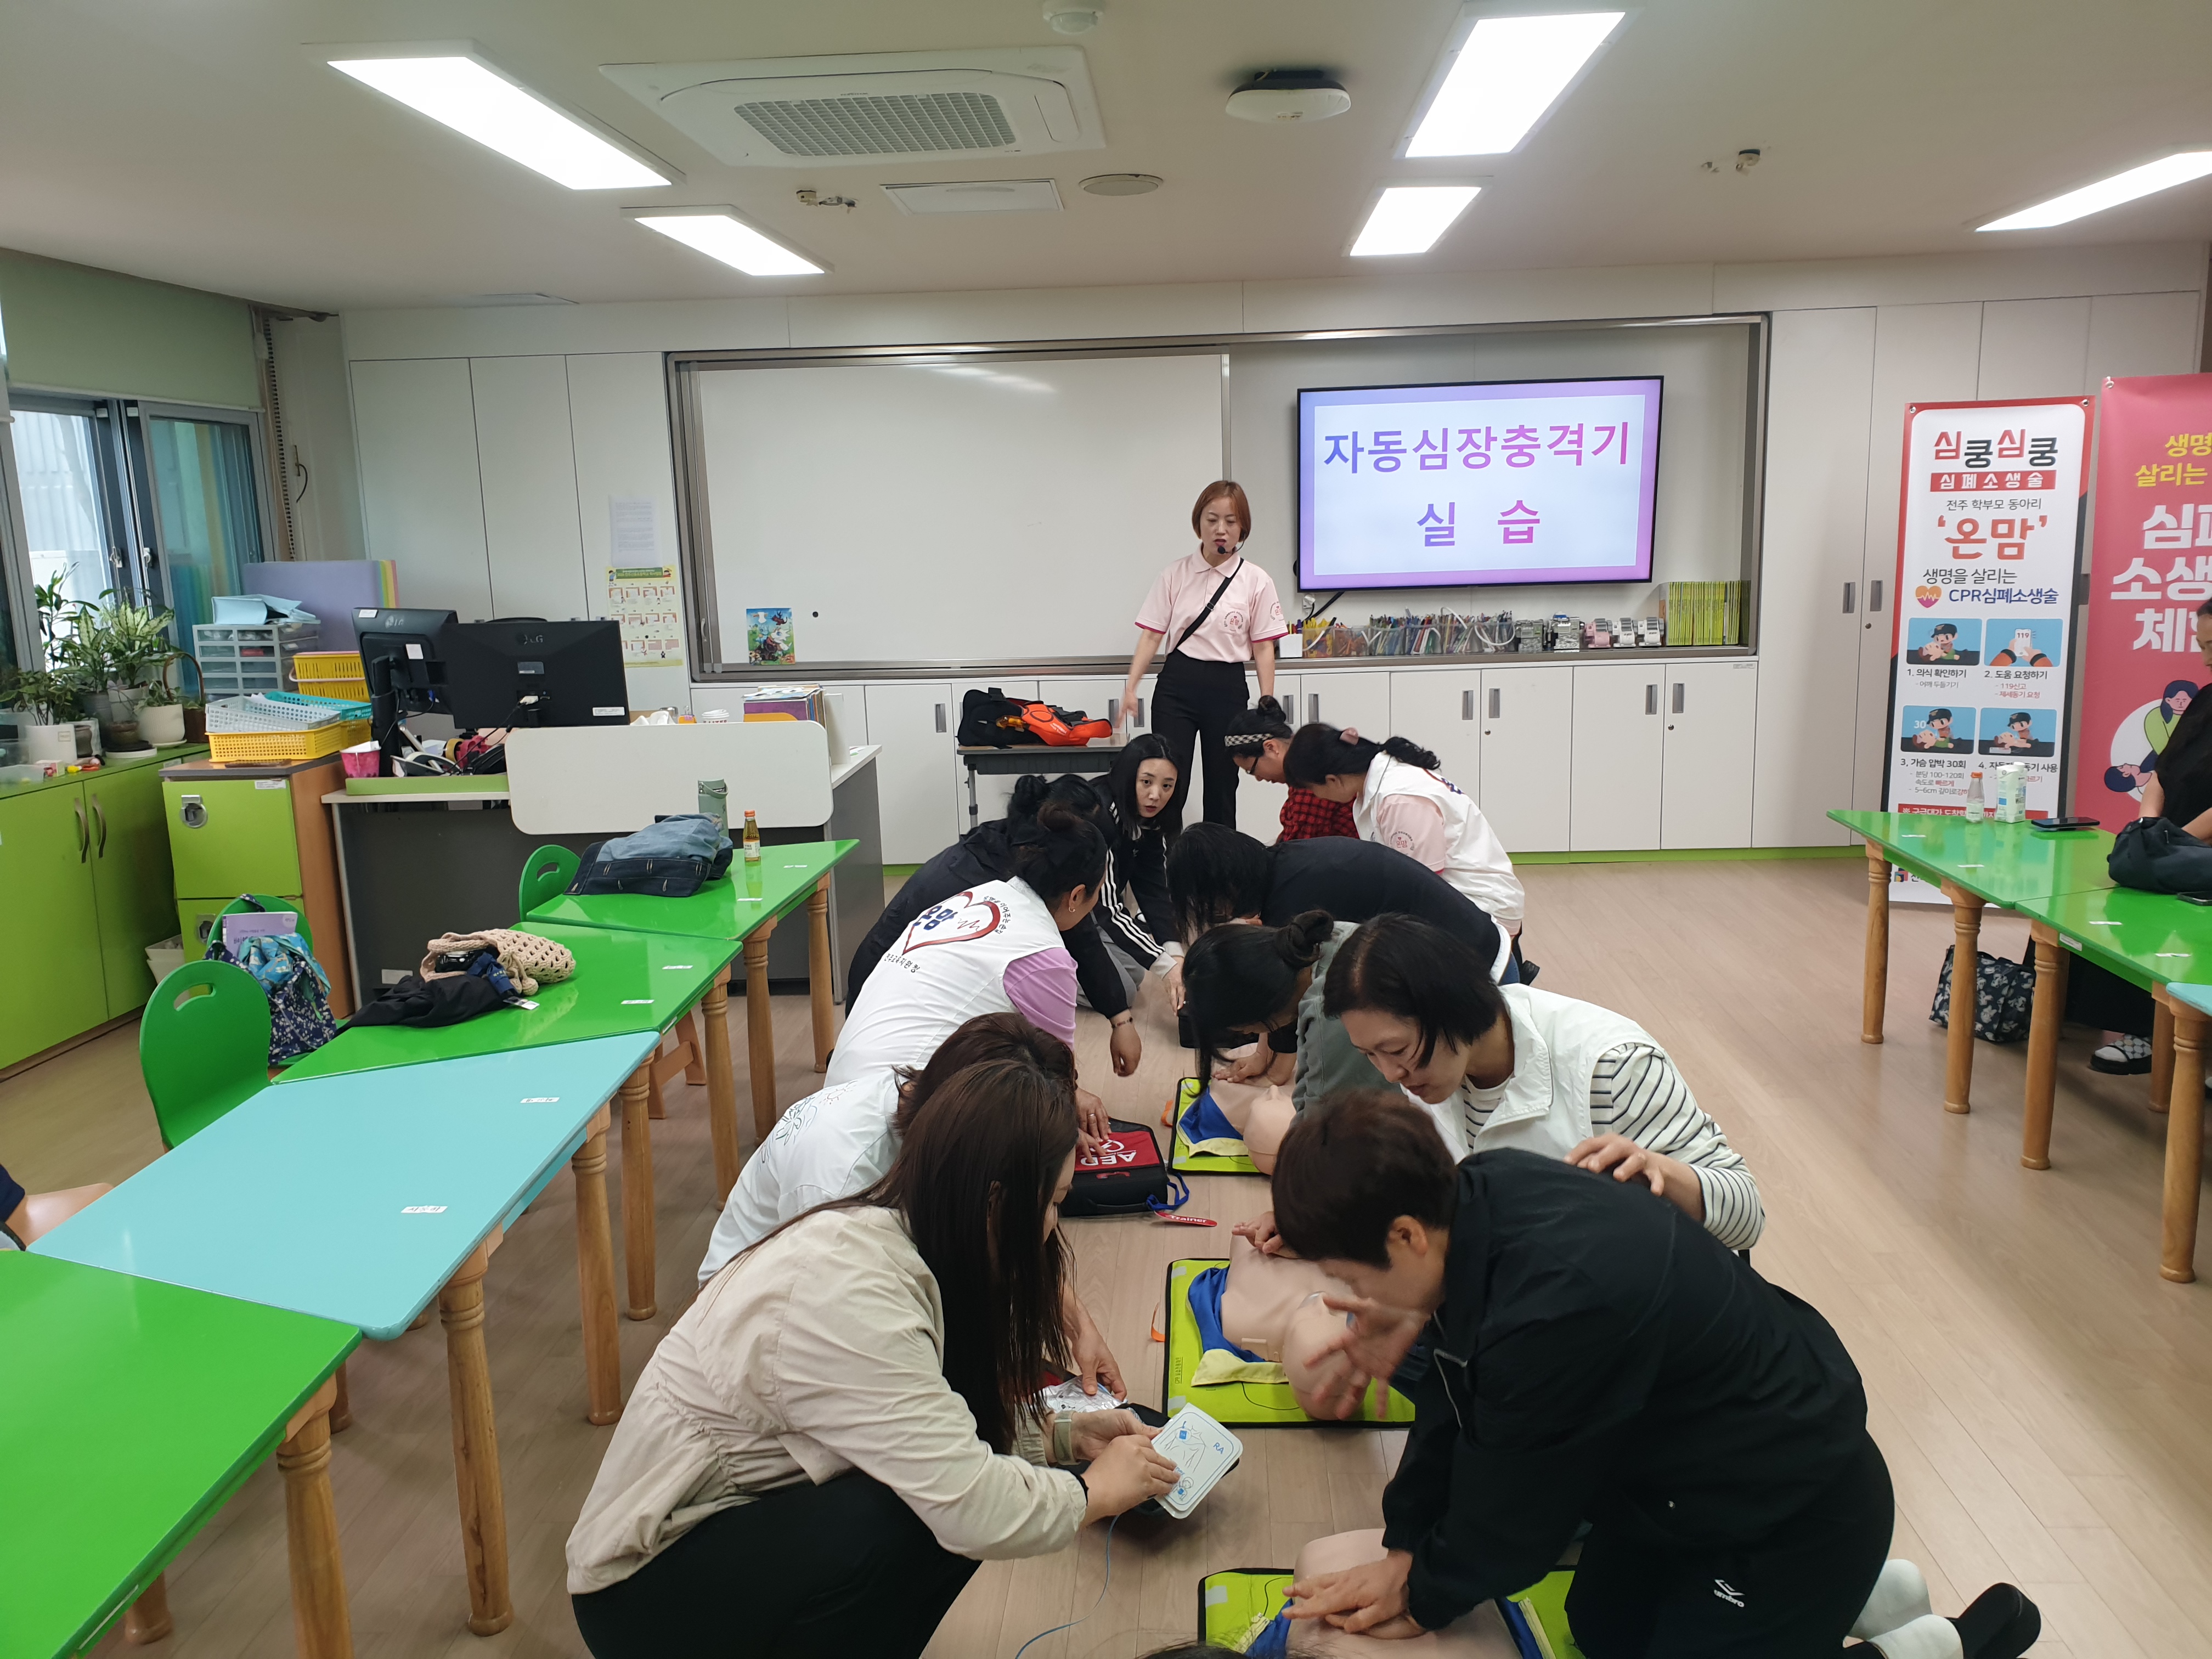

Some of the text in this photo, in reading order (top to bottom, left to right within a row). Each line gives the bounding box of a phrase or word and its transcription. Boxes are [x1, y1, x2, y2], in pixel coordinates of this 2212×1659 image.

[1323, 421, 1629, 475] 자동심장충격기
[1934, 429, 2058, 468] 심쿵심쿵
[1940, 472, 2044, 489] 심폐소생술
[2135, 462, 2208, 487] 살리는
[1946, 498, 2042, 511] 전주 학부모 동아리
[1923, 568, 2018, 584] 생명을 살리는
[1949, 588, 2059, 604] CPR심폐소생술
[1907, 668, 1967, 678] 1. 의식 확인하기
[1995, 670, 2012, 679] 도움
[2013, 670, 2048, 680] 요청하기
[1914, 720, 1927, 729] 30
[1911, 758, 1927, 768] 가슴
[1928, 759, 1945, 768] 압박
[1946, 760, 1966, 769] 30회
[2040, 763, 2058, 773] 사용
[1080, 1152, 1137, 1166] AED
[1170, 1215, 1207, 1223] Trainer
[1213, 1442, 1224, 1454] RA
[1714, 1589, 1745, 1607] umbro
